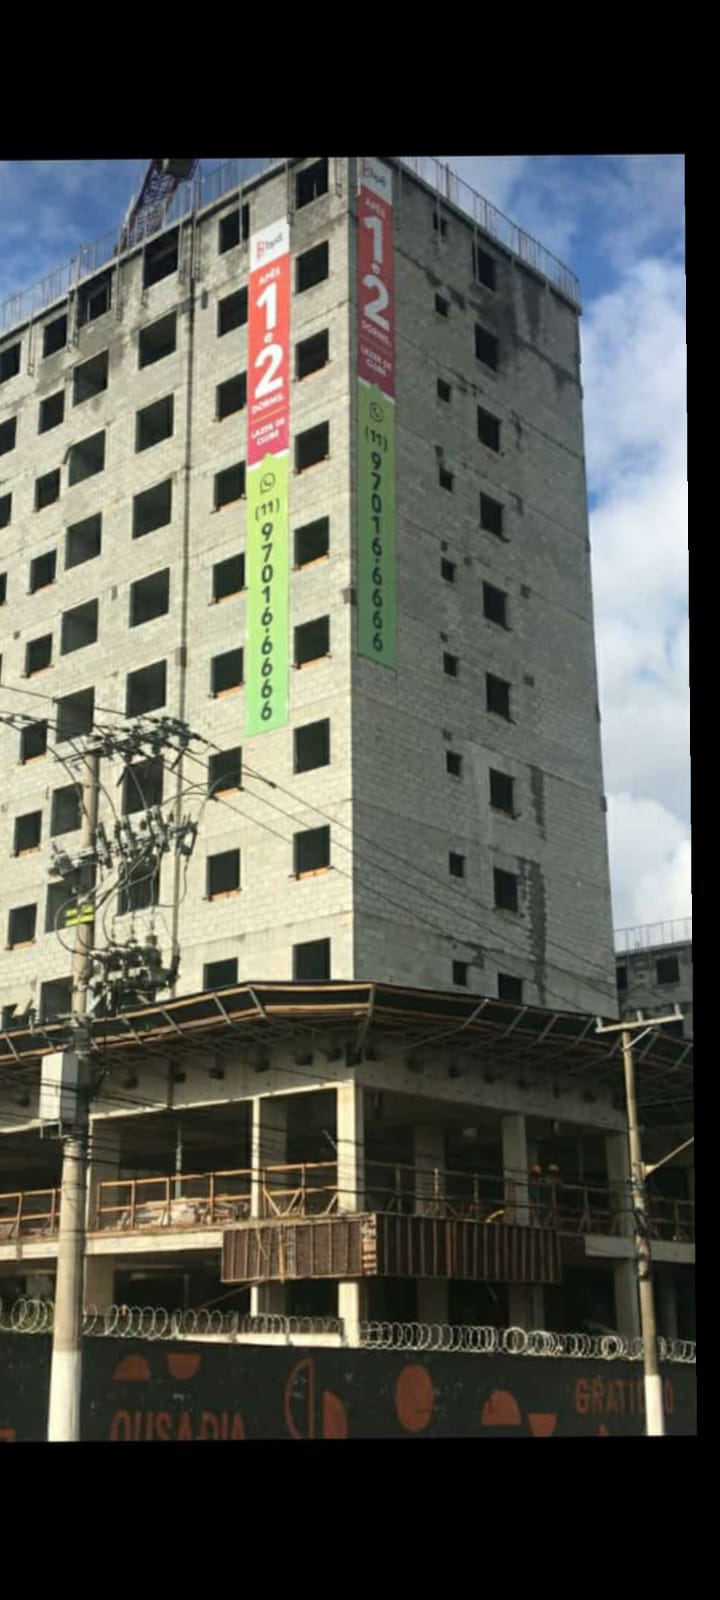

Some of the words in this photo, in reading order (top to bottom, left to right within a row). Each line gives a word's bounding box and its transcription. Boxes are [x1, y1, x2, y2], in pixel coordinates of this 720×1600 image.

[364, 216, 383, 264] 1
[256, 283, 277, 331] 1
[362, 274, 390, 331] 2
[263, 332, 273, 344] e
[254, 344, 284, 400] 2
[364, 425, 388, 453] (11)
[255, 497, 280, 522] (11)
